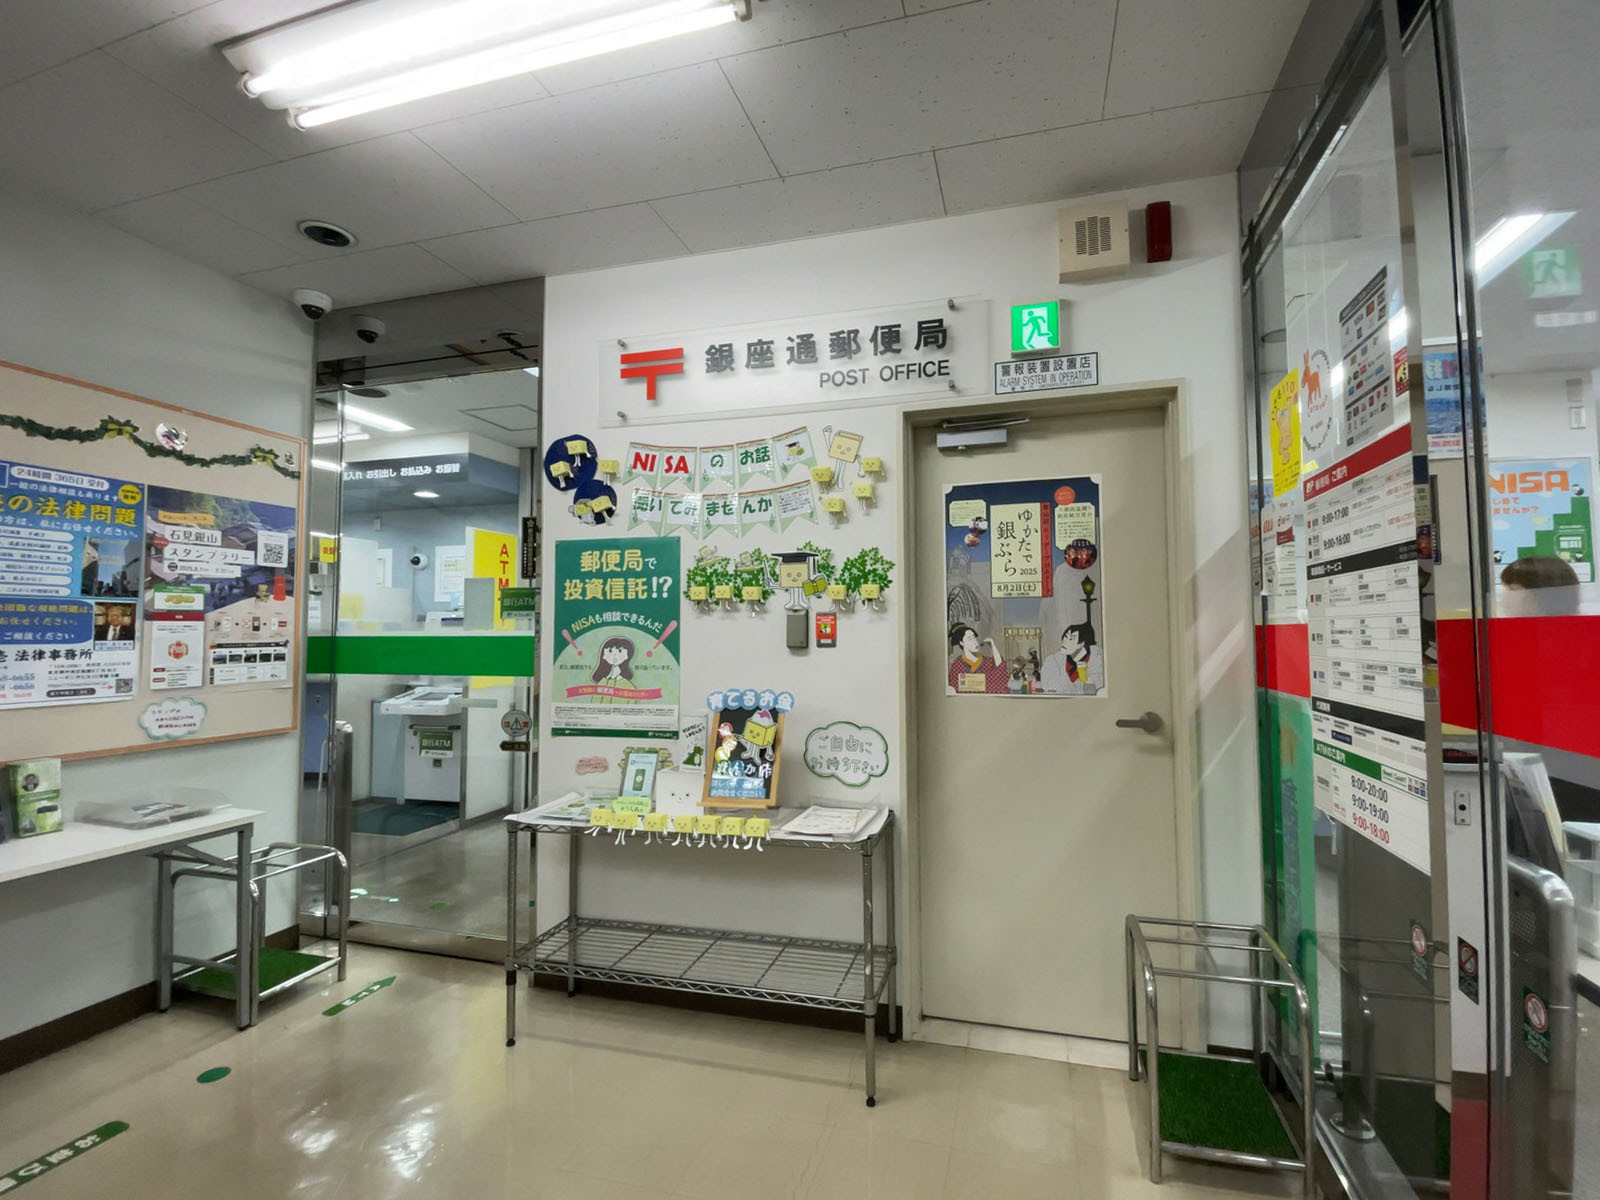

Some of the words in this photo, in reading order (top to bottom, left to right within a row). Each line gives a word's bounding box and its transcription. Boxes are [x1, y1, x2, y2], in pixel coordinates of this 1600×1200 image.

[705, 318, 948, 374] 銀座通郵便局
[819, 368, 869, 388] POST
[879, 359, 951, 382] OFFICE
[1001, 356, 1091, 377] 警報装置設置店
[1000, 377, 1020, 388] ALARM
[1022, 374, 1047, 385] SYSTEM
[1049, 373, 1056, 383] IN
[1059, 370, 1092, 382] OPERATION
[17, 467, 52, 480] 24時間
[55, 472, 84, 485] 365日
[87, 478, 105, 489] 受付
[366, 468, 396, 479] お引出し
[400, 466, 432, 476] お払込み
[0, 494, 136, 527] の法律問題
[169, 529, 218, 544] 石見銀山
[1017, 508, 1039, 564] ゆかたで
[169, 547, 251, 561] スタンプラリー
[994, 521, 1017, 577] 銀ぶら
[498, 543, 510, 589] ATM
[580, 549, 657, 573] 郵便局で
[1020, 567, 1038, 576] 2025
[996, 582, 1037, 593] 8月2日(土)
[571, 611, 663, 633] NISAも相談できるんだ
[14, 648, 93, 661] 法律事務所
[708, 690, 794, 712] 育てるお金
[818, 735, 873, 755] ご自由に
[1351, 775, 1388, 803] 8:00-20:00
[1352, 793, 1390, 824] 9:00-19:00
[1353, 812, 1391, 845] 9:00-18:00
